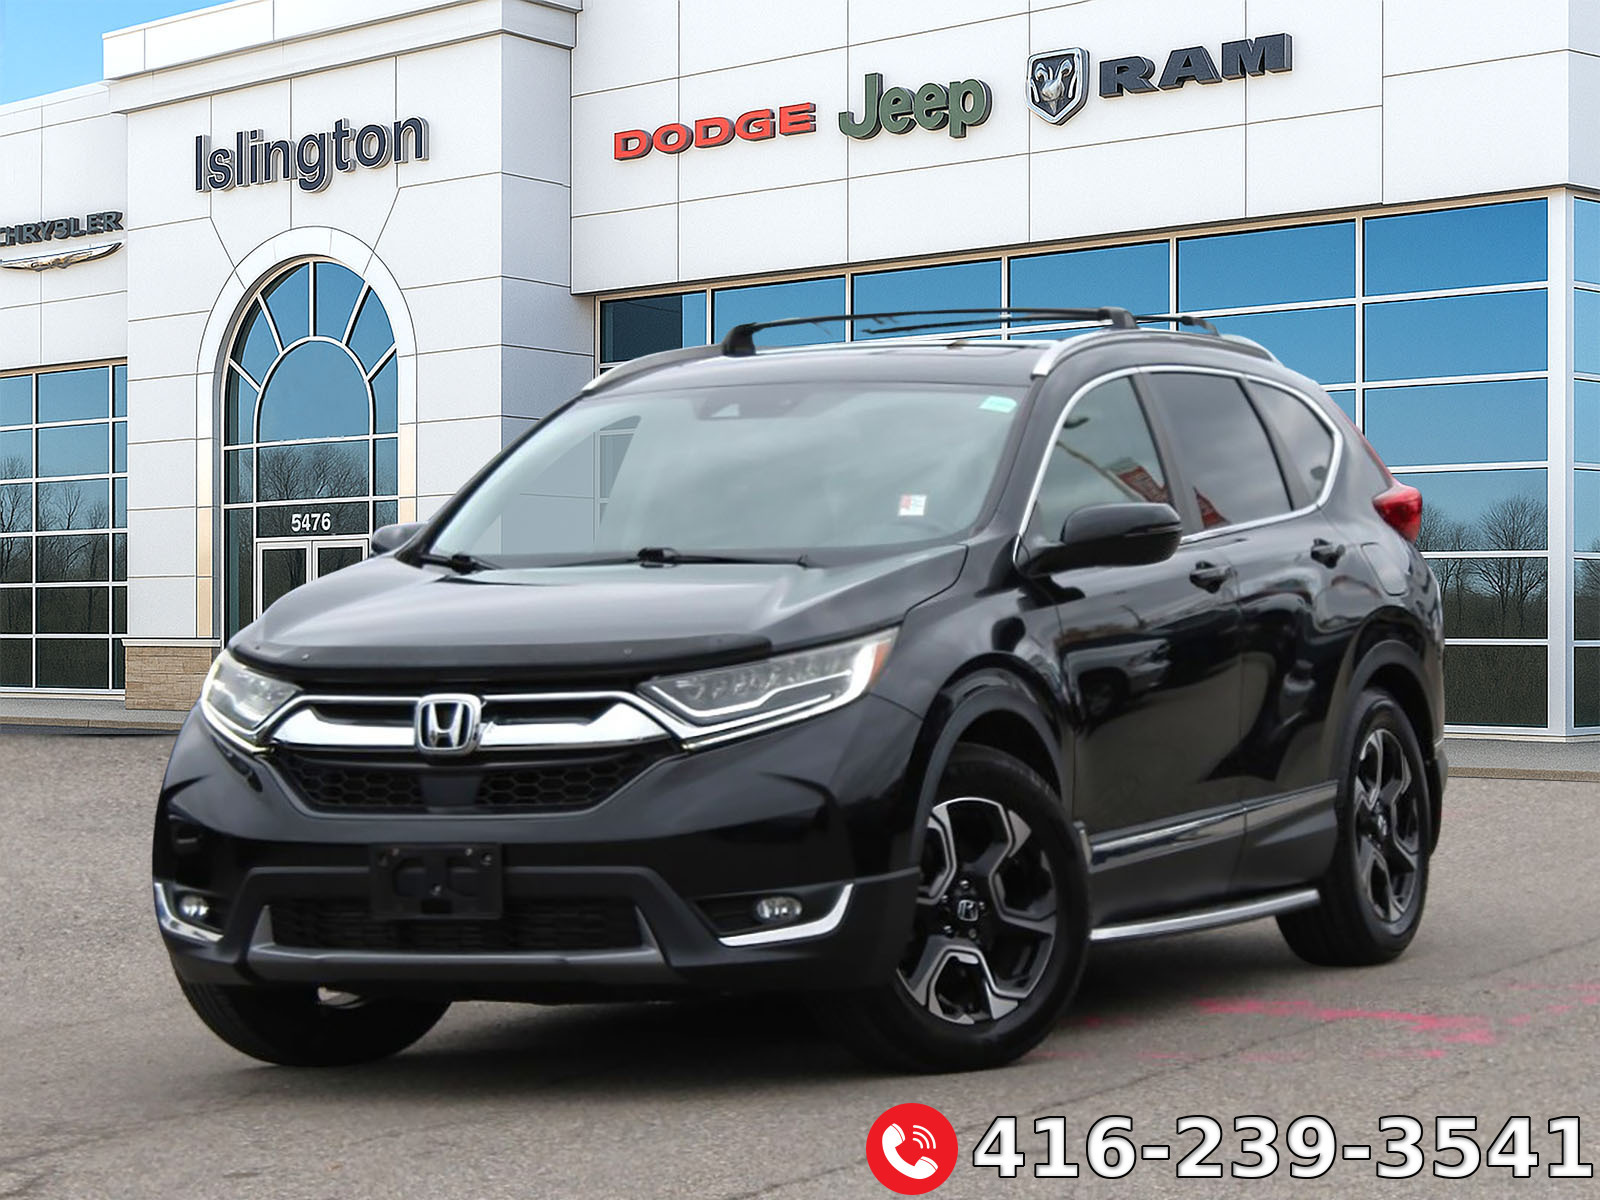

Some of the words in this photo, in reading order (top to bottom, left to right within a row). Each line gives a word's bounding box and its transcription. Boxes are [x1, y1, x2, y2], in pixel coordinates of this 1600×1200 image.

[1100, 33, 1293, 98] RAM
[614, 102, 817, 160] DODGE
[838, 73, 992, 139] Jeep
[195, 116, 429, 192] Islington
[291, 512, 331, 532] 5476
